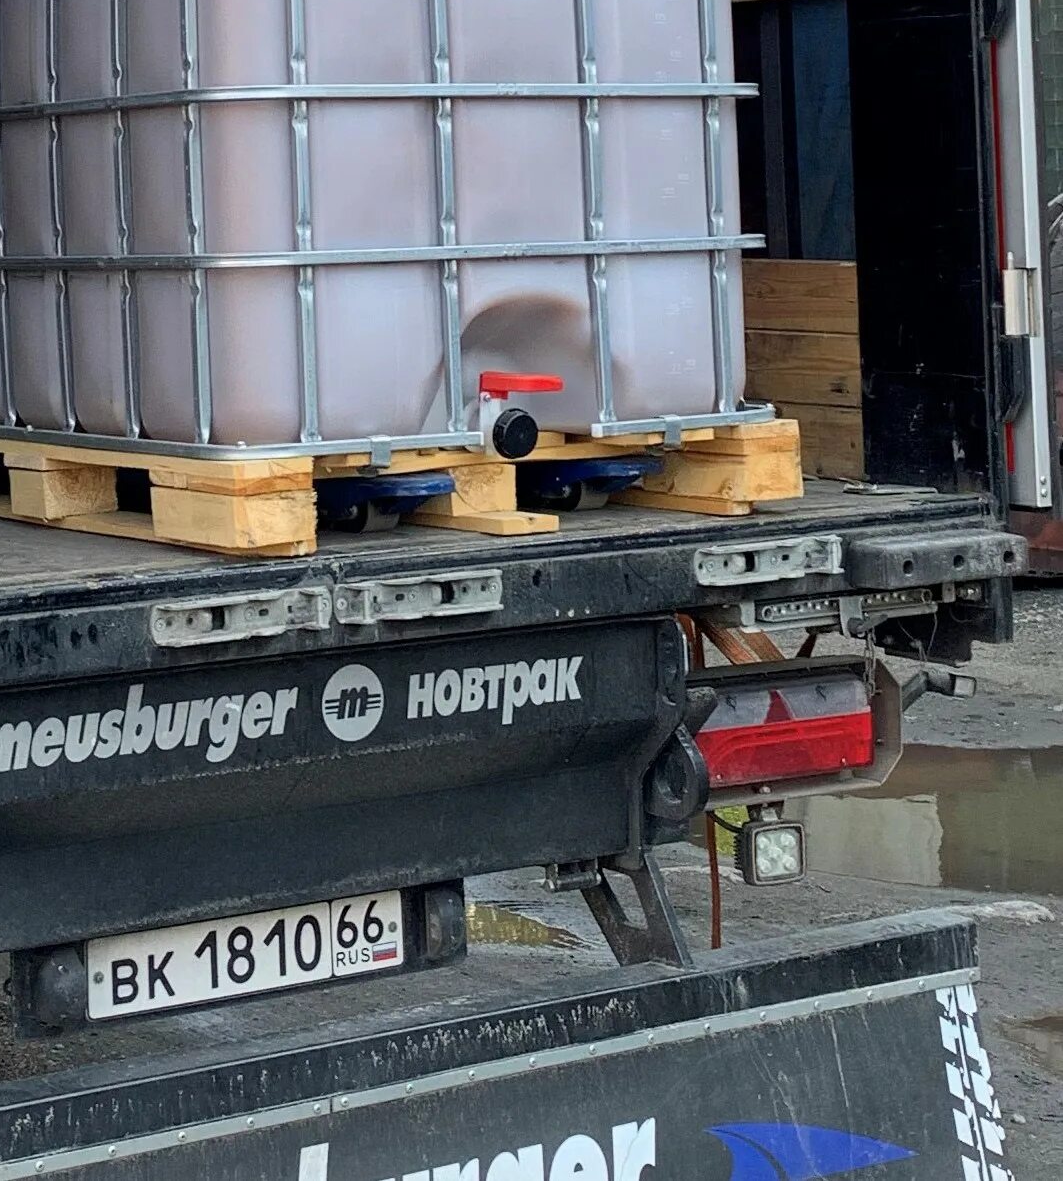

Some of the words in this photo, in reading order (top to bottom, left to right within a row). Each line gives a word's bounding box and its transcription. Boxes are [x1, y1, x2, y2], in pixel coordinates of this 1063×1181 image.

[194, 914, 322, 989] 1810
[336, 900, 385, 949] 66
[336, 947, 371, 968] RUS
